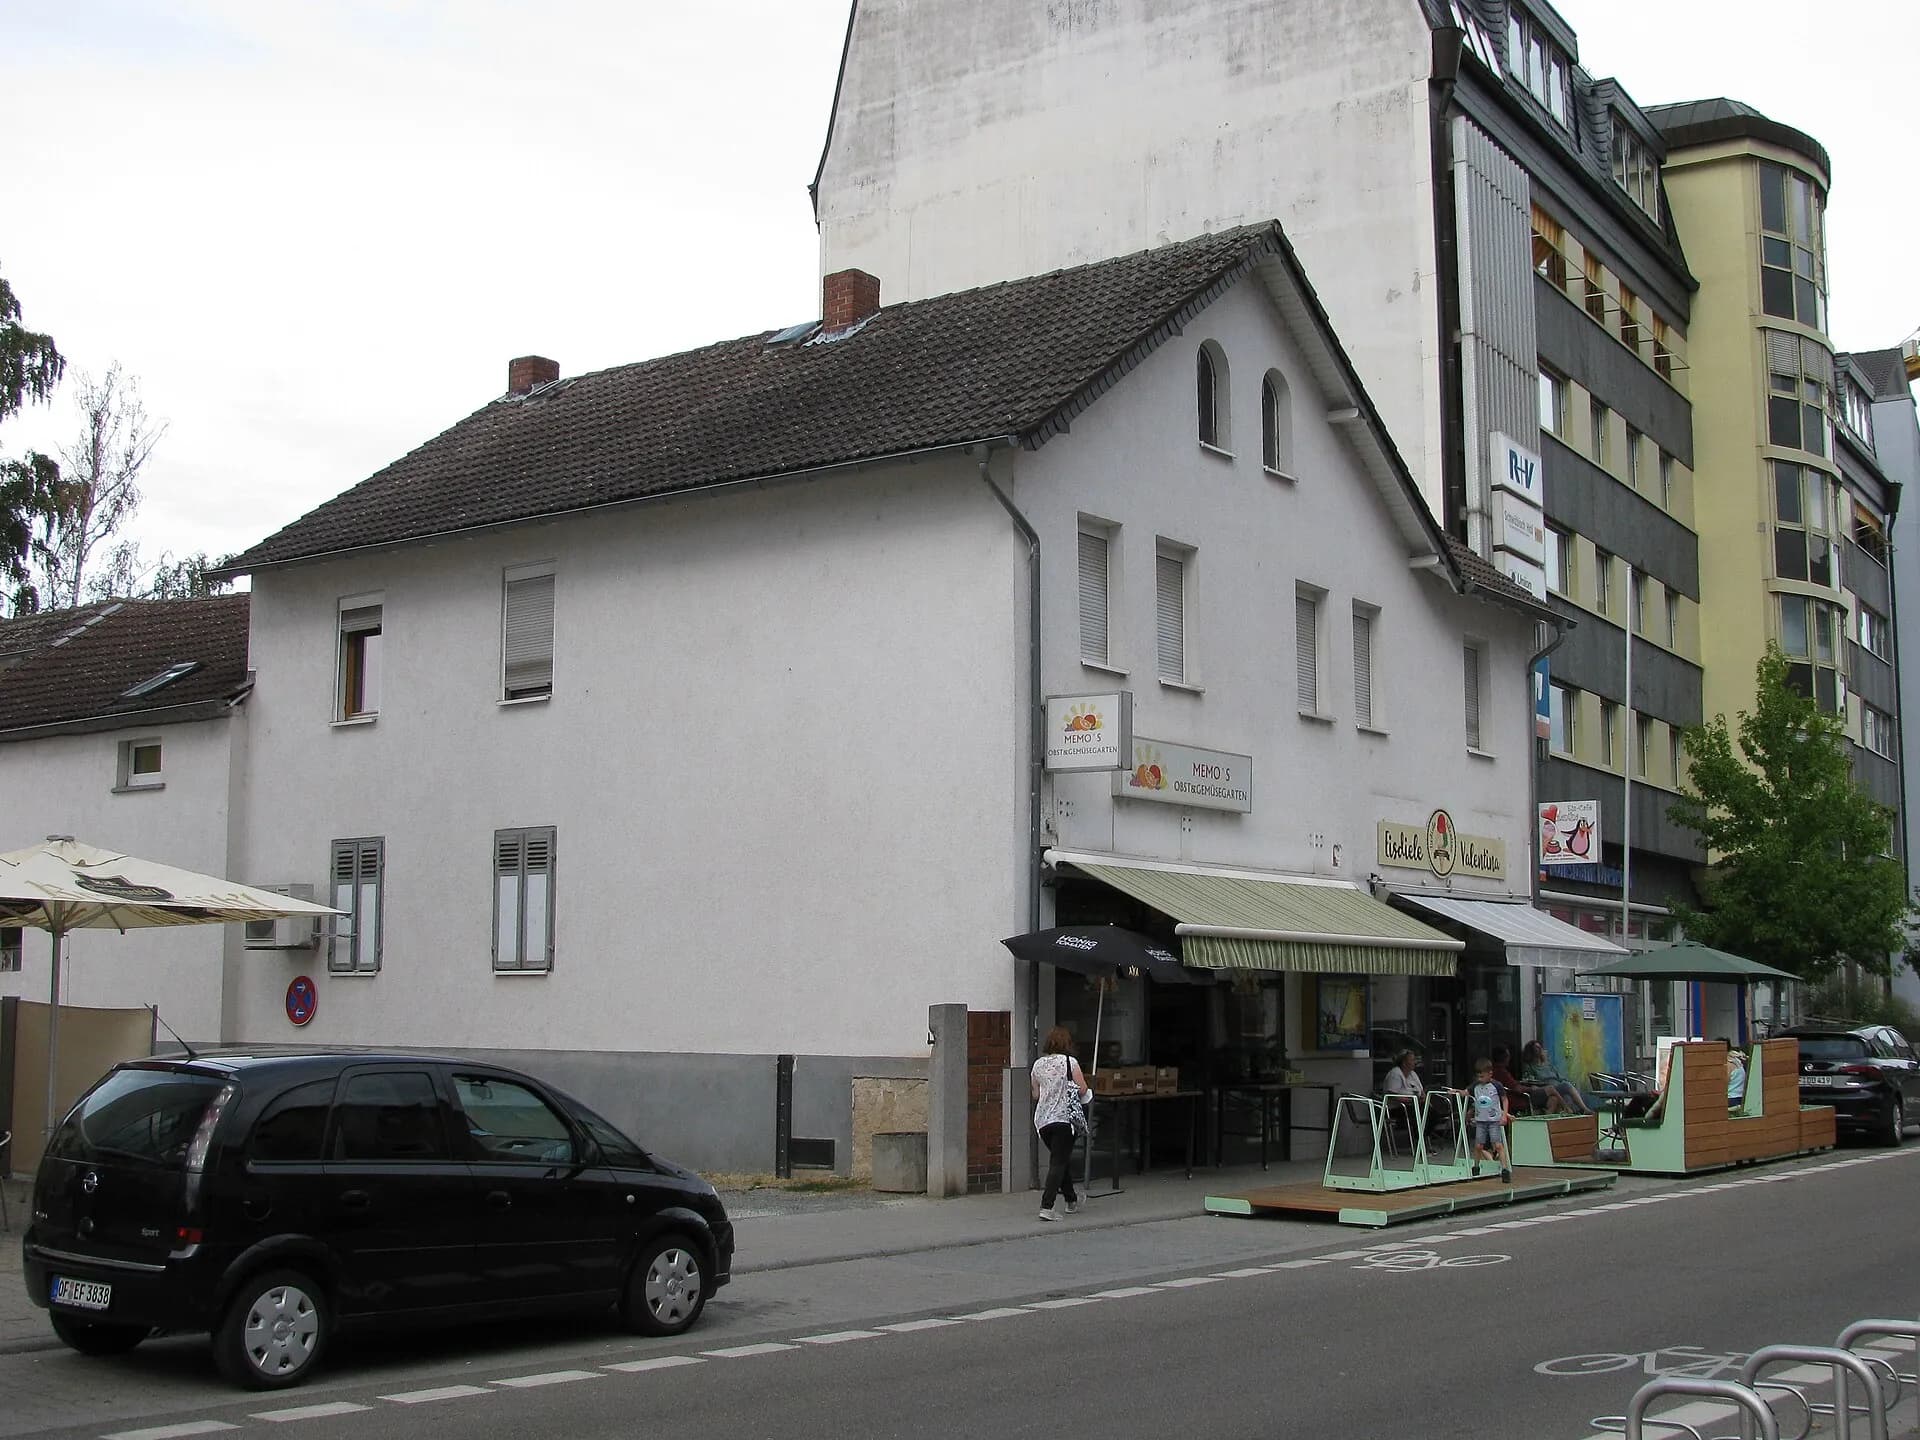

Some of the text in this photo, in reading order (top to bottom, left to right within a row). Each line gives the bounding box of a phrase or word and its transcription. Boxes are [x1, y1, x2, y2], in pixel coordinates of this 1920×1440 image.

[1509, 448, 1535, 490] R+V
[1173, 781, 1248, 801] OBST&GEMÜSEGARTEN
[1384, 830, 1424, 861] Eisdiele
[1460, 840, 1501, 872] Valentina
[1058, 934, 1098, 947] HONIG
[58, 1280, 110, 1304] OF EF 3838
